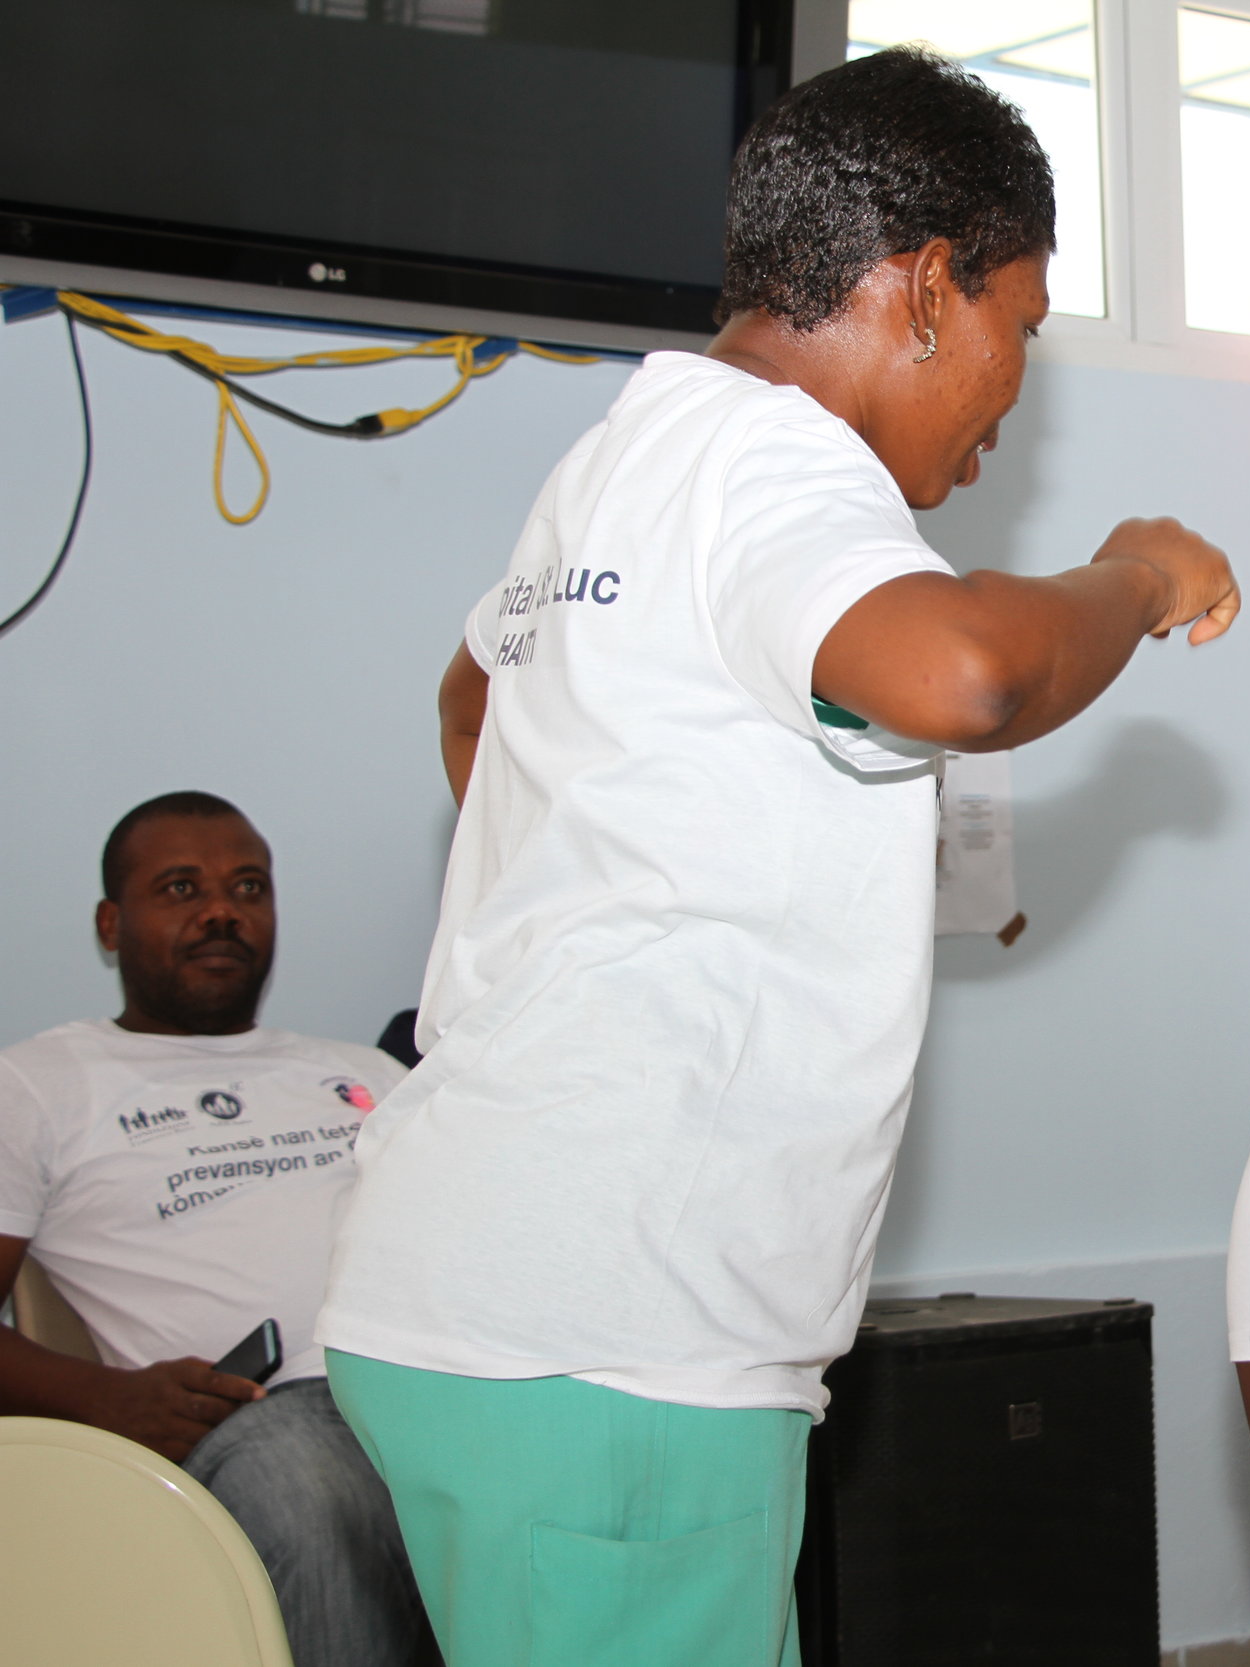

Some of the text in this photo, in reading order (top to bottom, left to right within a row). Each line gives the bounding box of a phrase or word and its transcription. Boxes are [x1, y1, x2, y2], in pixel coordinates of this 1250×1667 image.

[553, 557, 621, 605] Luc
[271, 1130, 315, 1146] nan
[167, 1155, 308, 1193] prevansyon
